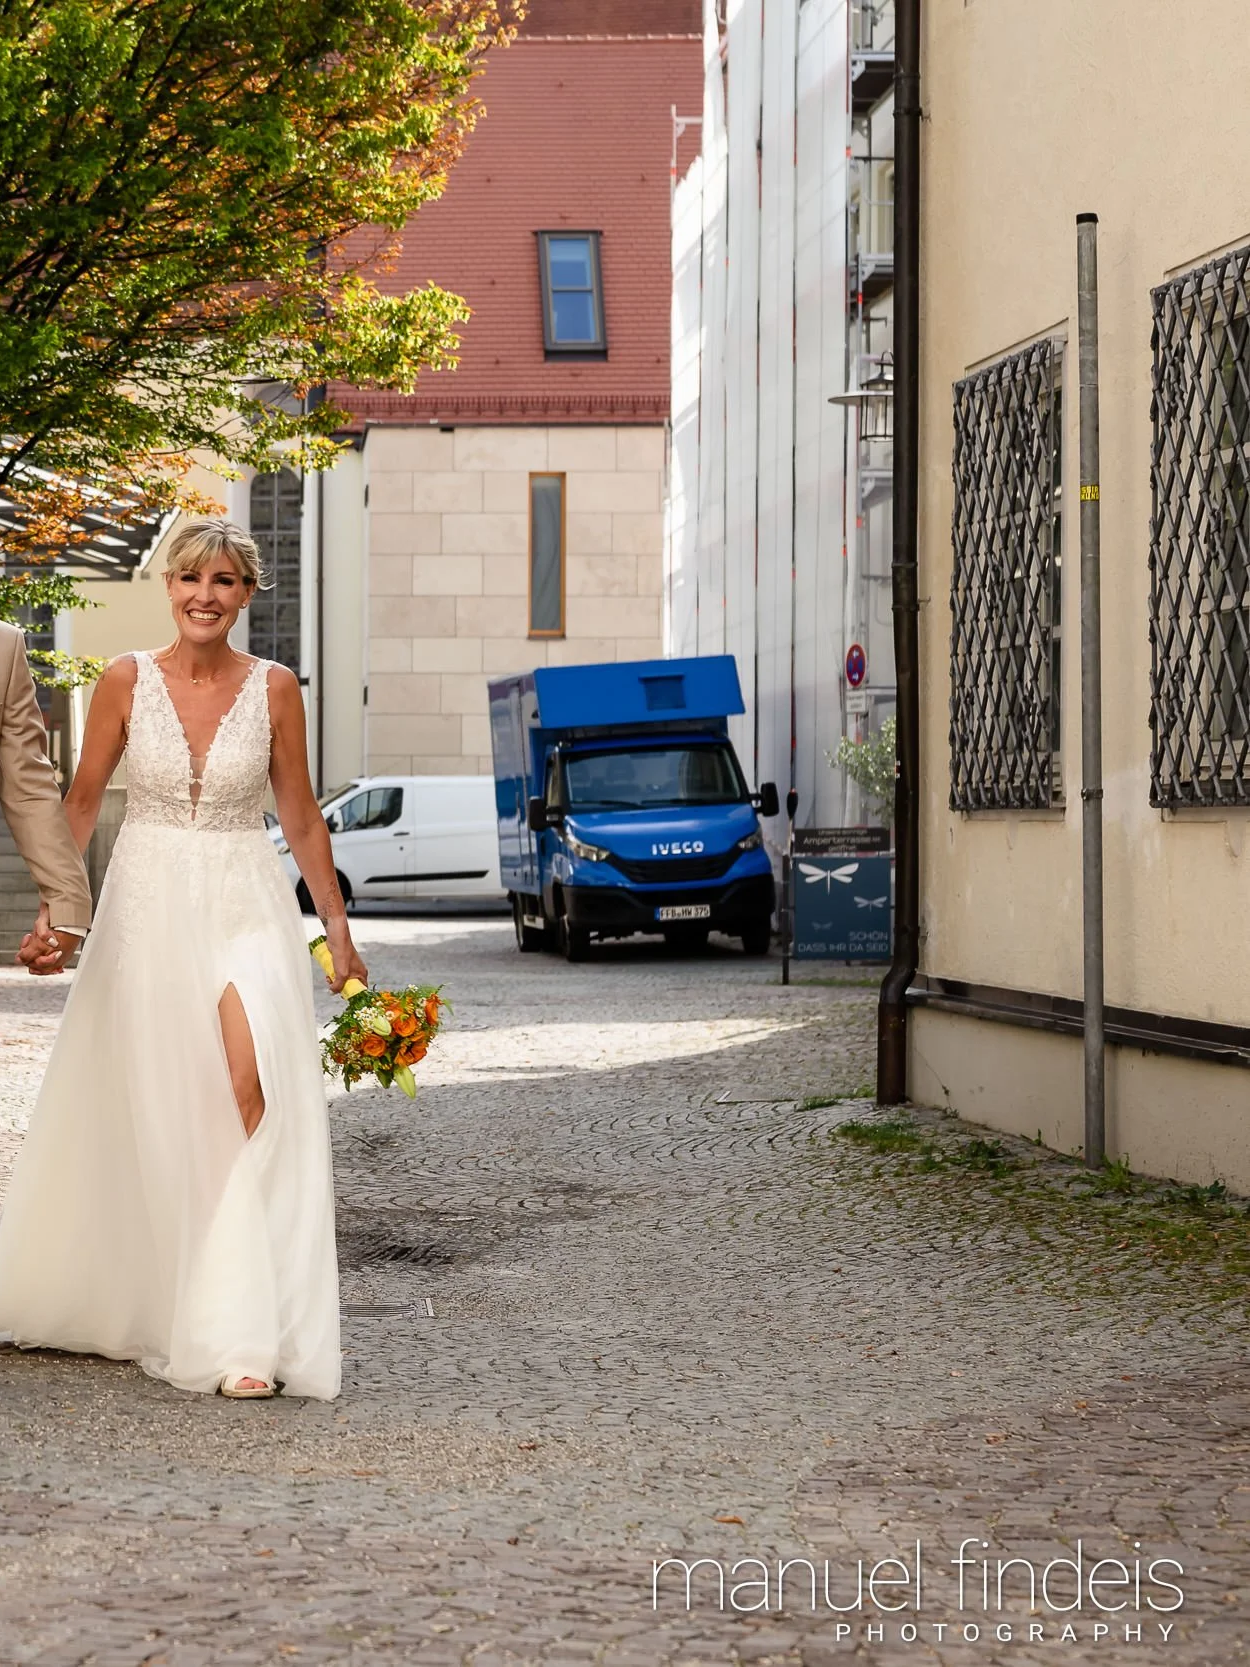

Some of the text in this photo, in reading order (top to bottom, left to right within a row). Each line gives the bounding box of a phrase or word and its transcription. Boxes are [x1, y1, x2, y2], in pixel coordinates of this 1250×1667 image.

[652, 841, 704, 856] IVECO
[849, 930, 888, 941] SCHÖN
[798, 942, 888, 953] DASS IHR DA SEID
